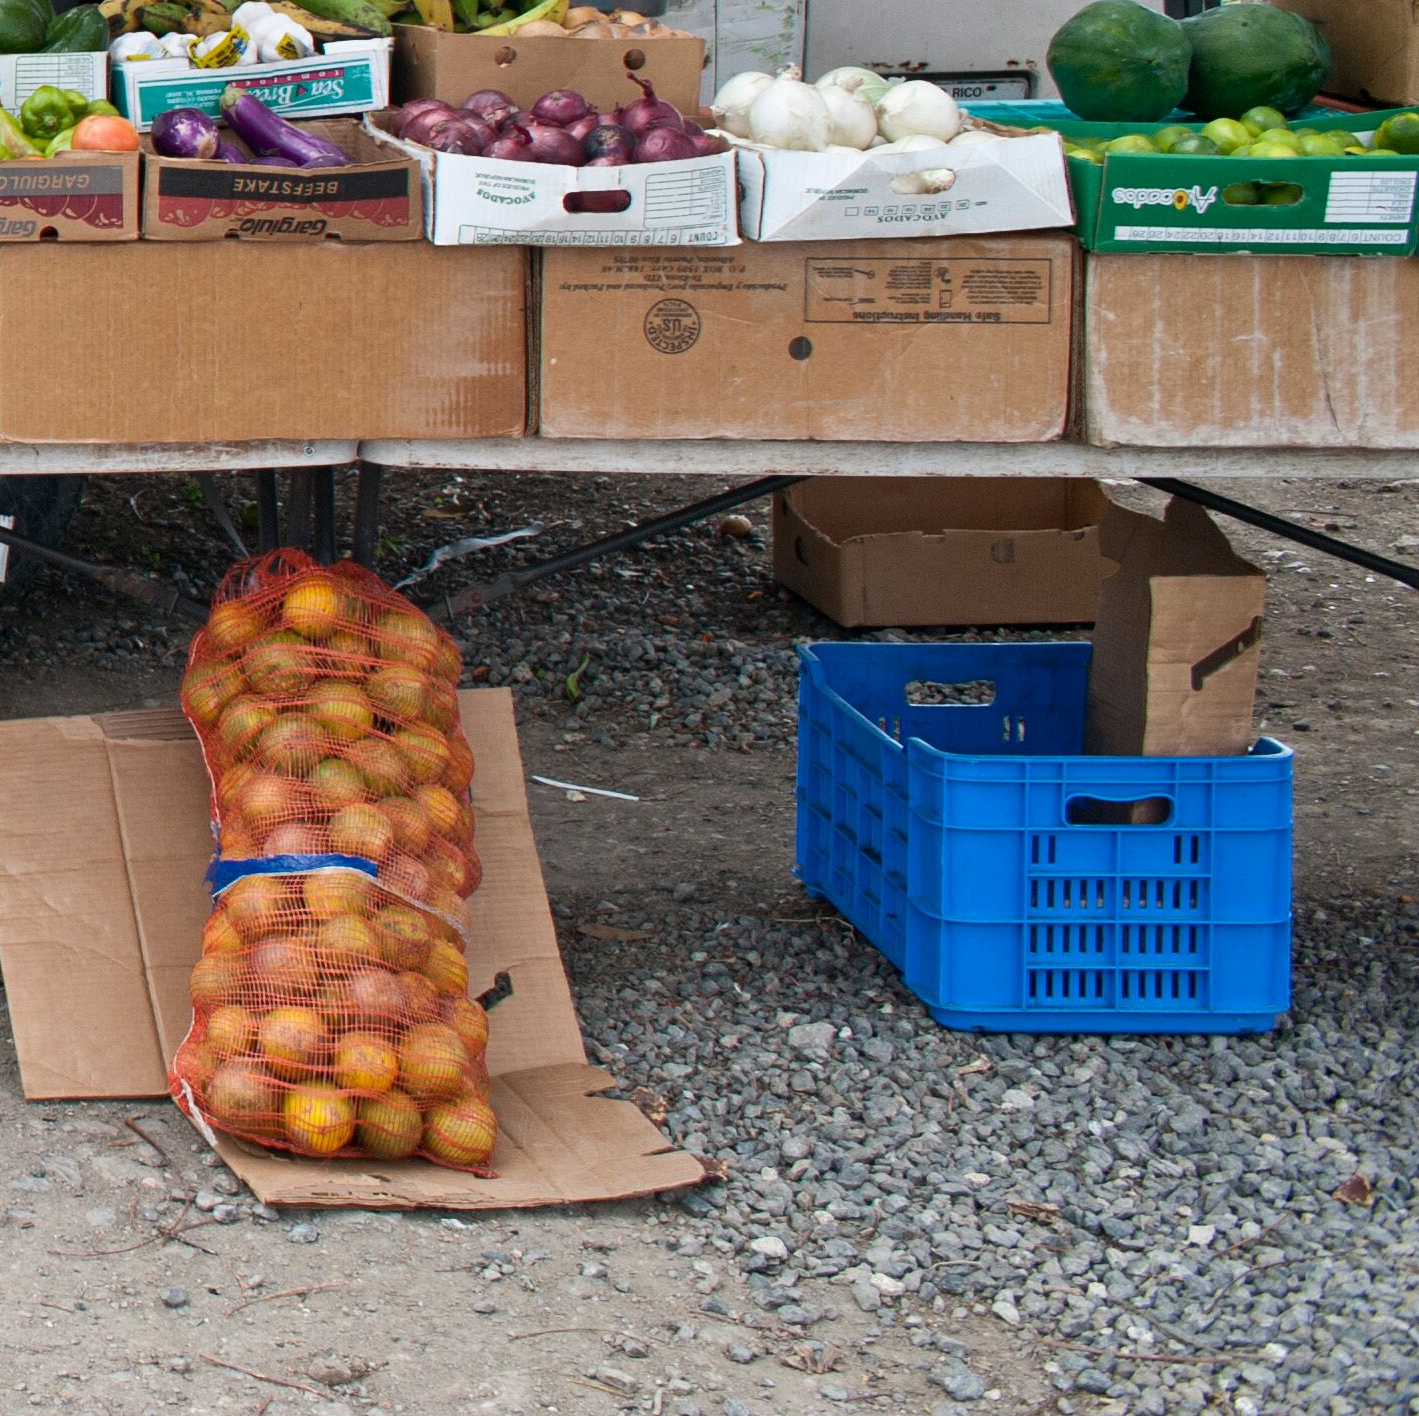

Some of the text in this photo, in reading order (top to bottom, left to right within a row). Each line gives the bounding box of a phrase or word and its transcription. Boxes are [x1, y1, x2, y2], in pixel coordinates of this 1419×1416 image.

[310, 79, 344, 99] Sea
[953, 87, 982, 97] RICO
[233, 179, 338, 196] BEEFSTAKE
[476, 189, 535, 205] AVOCADOS
[876, 212, 947, 223] AVOCADOS
[239, 217, 327, 236] Gargiulo
[586, 235, 595, 244] 12
[630, 235, 637, 244] 9
[644, 235, 651, 244] 8
[657, 235, 664, 244] 7
[670, 234, 677, 244] 6
[688, 231, 717, 243] COUNT
[1267, 232, 1280, 241] 12
[1300, 232, 1312, 242] 10
[1351, 233, 1359, 242] 6
[1363, 233, 1402, 242] COUNT
[853, 311, 1001, 322] Safe Handling Instructions
[648, 326, 697, 352] INSPECTED
